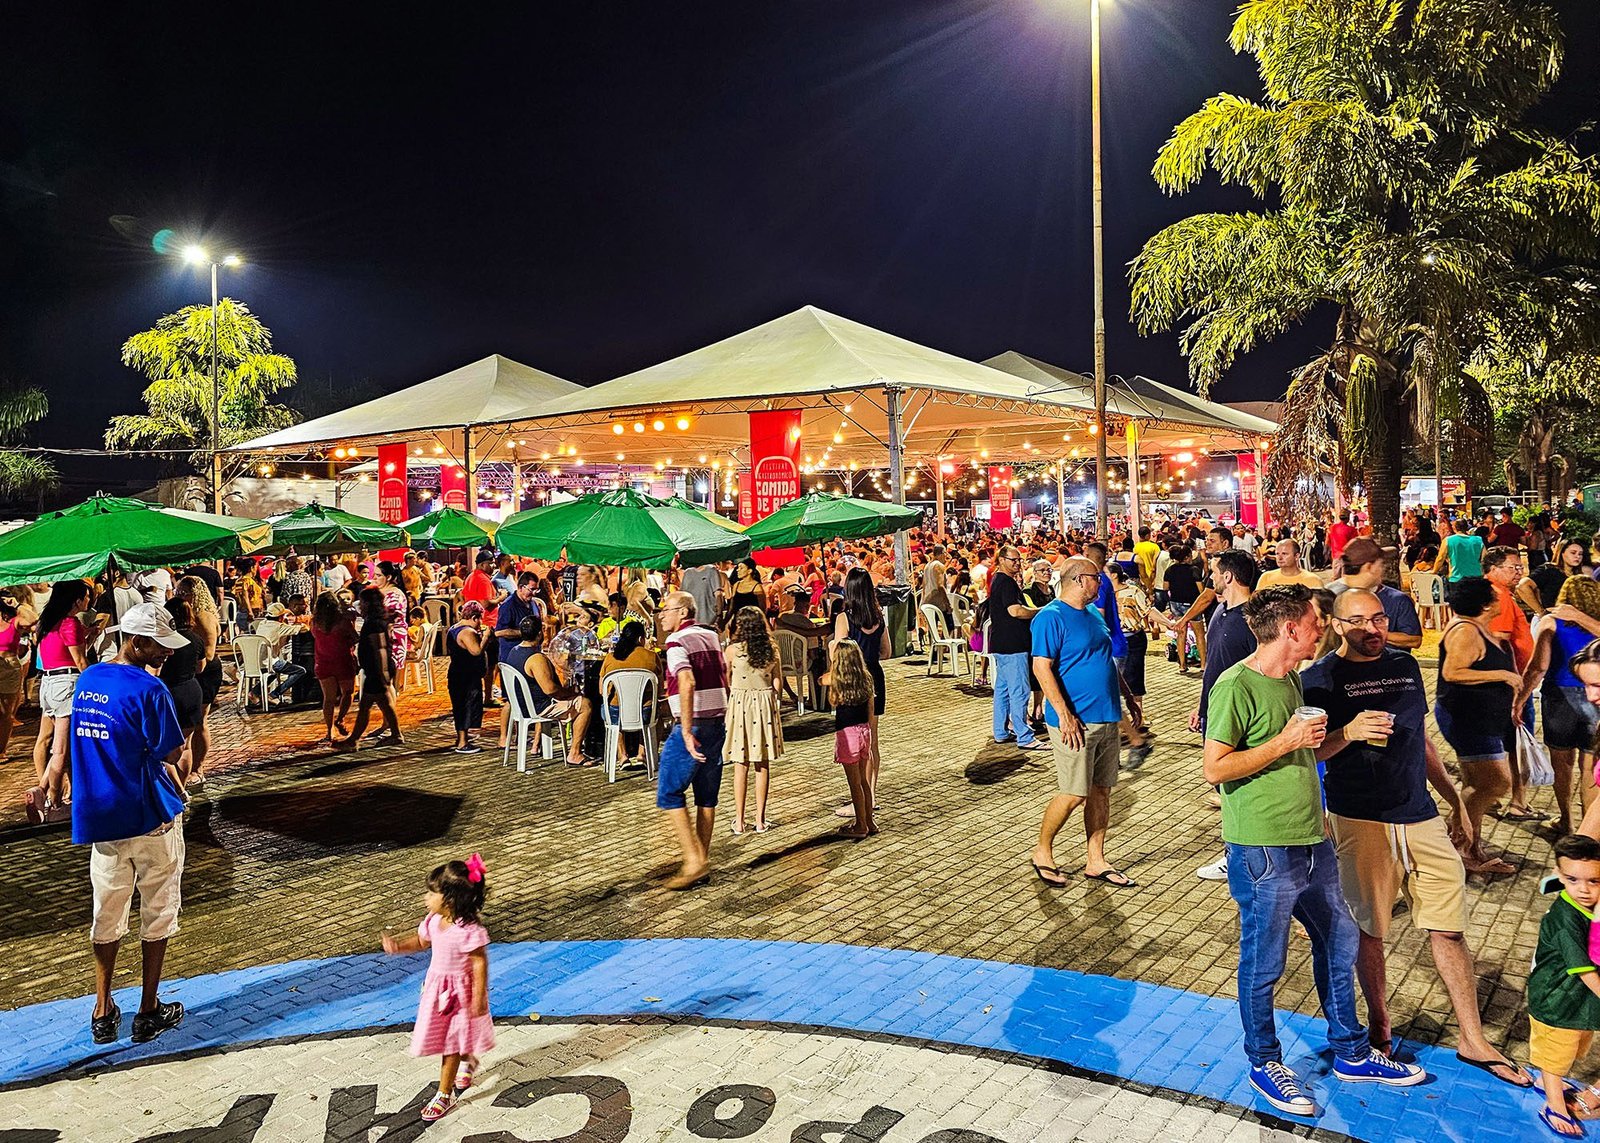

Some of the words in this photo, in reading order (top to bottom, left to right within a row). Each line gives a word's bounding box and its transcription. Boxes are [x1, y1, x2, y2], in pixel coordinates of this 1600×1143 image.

[756, 480, 797, 496] COMIDA
[758, 497, 769, 512] DE
[380, 509, 389, 521] DE
[390, 509, 402, 520] RU
[1344, 682, 1365, 691] Calvin
[1366, 680, 1381, 688] Klein
[78, 691, 109, 704] APOIO
[1347, 689, 1368, 697] Calvin
